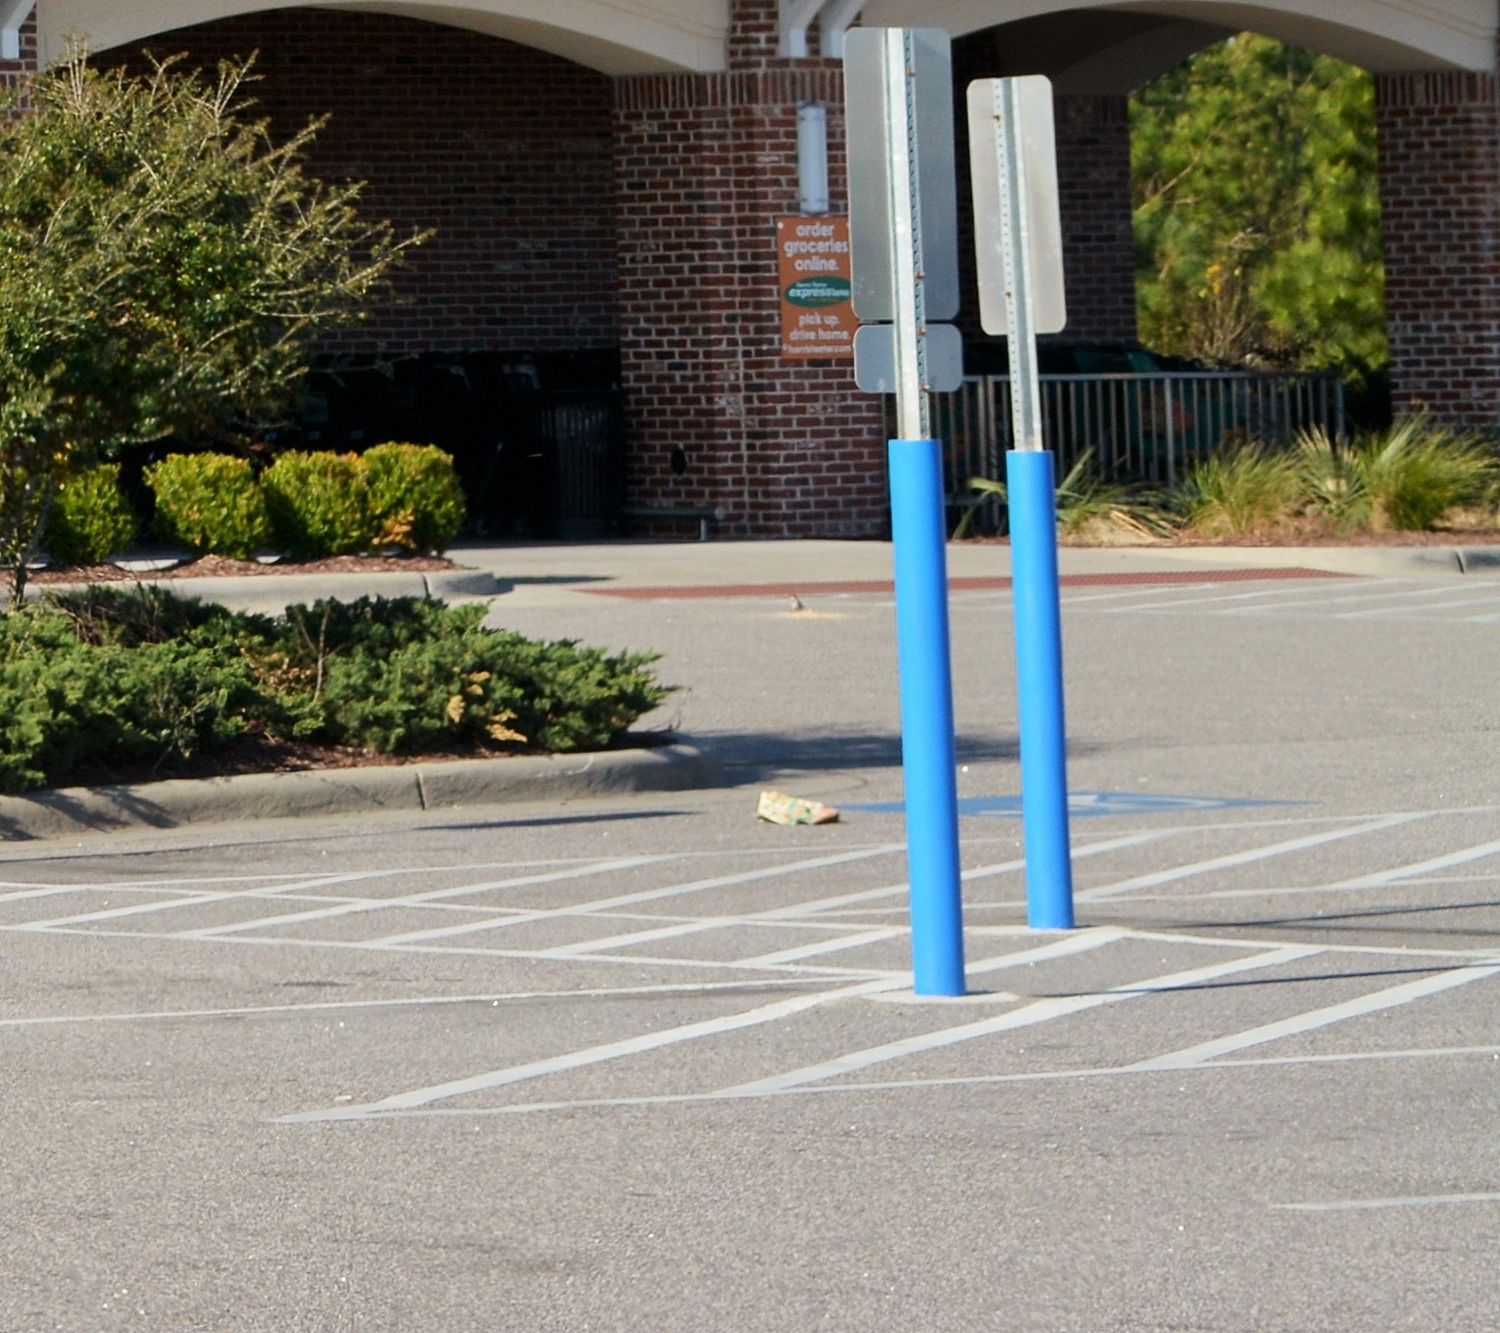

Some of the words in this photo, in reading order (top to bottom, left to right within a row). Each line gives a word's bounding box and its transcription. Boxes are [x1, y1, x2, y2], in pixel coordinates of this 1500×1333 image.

[796, 222, 835, 236] order
[784, 238, 848, 258] groceries
[794, 255, 839, 271] online.
[799, 312, 821, 327] pick
[790, 329, 816, 340] drive
